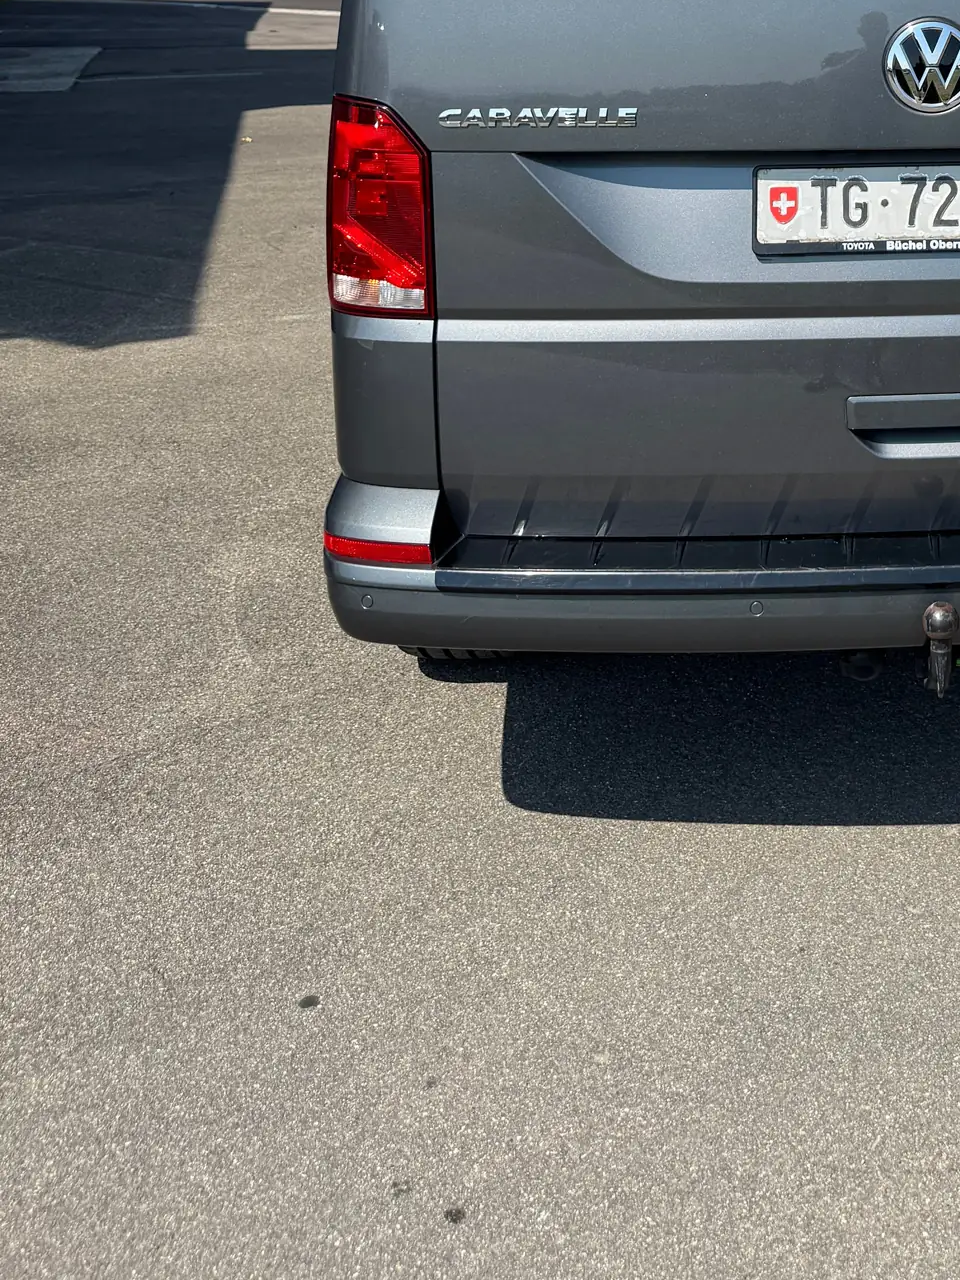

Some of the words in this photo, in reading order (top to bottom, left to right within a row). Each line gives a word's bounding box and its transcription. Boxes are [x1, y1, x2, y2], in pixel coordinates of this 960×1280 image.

[438, 107, 638, 128] CARAVELLE
[842, 241, 875, 251] TOYOTA
[886, 239, 927, 251] Büchel
